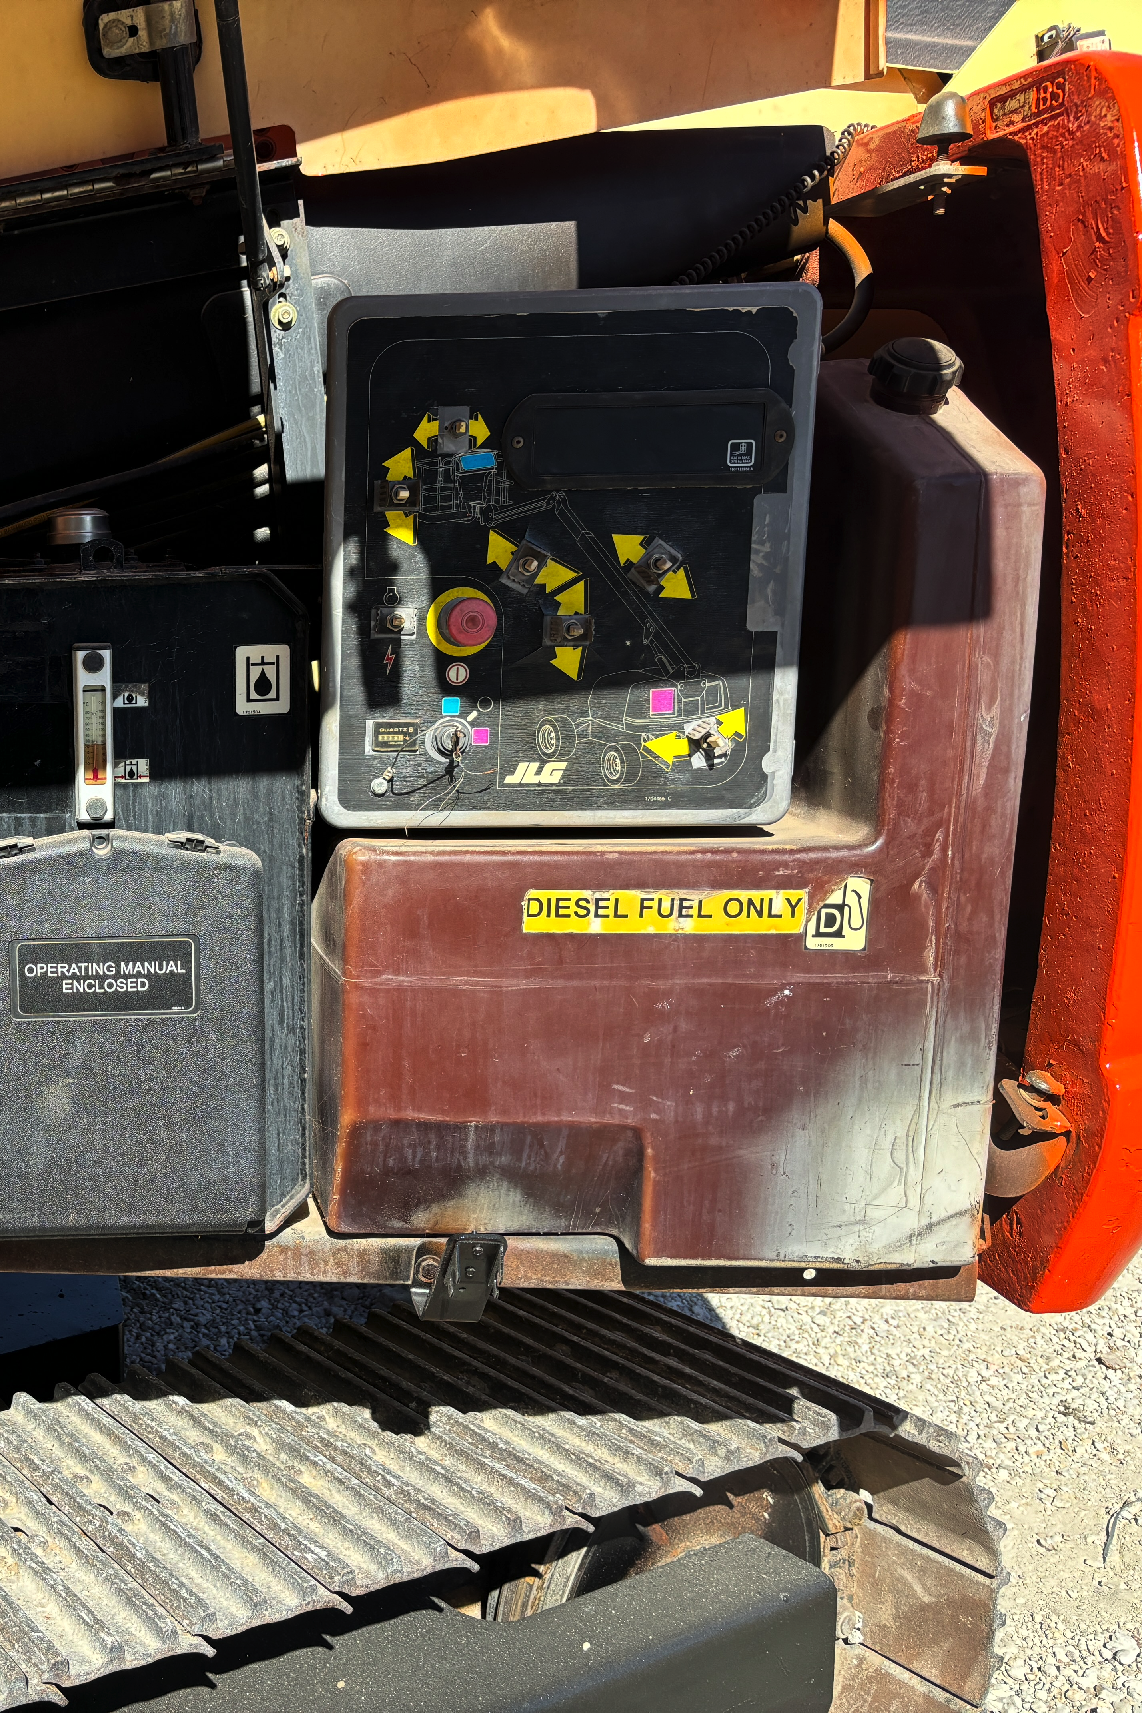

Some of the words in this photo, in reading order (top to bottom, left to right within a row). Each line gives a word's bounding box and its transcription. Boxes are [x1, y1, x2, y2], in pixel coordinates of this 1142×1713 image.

[503, 761, 568, 784] JLG
[526, 897, 629, 919] DIESEL
[638, 897, 712, 919] FUEL
[723, 896, 804, 919] ONLY
[819, 908, 842, 933] D
[24, 962, 116, 977] OPERATING
[120, 960, 186, 975] MANUAL
[62, 978, 149, 993] ENCLOSED
